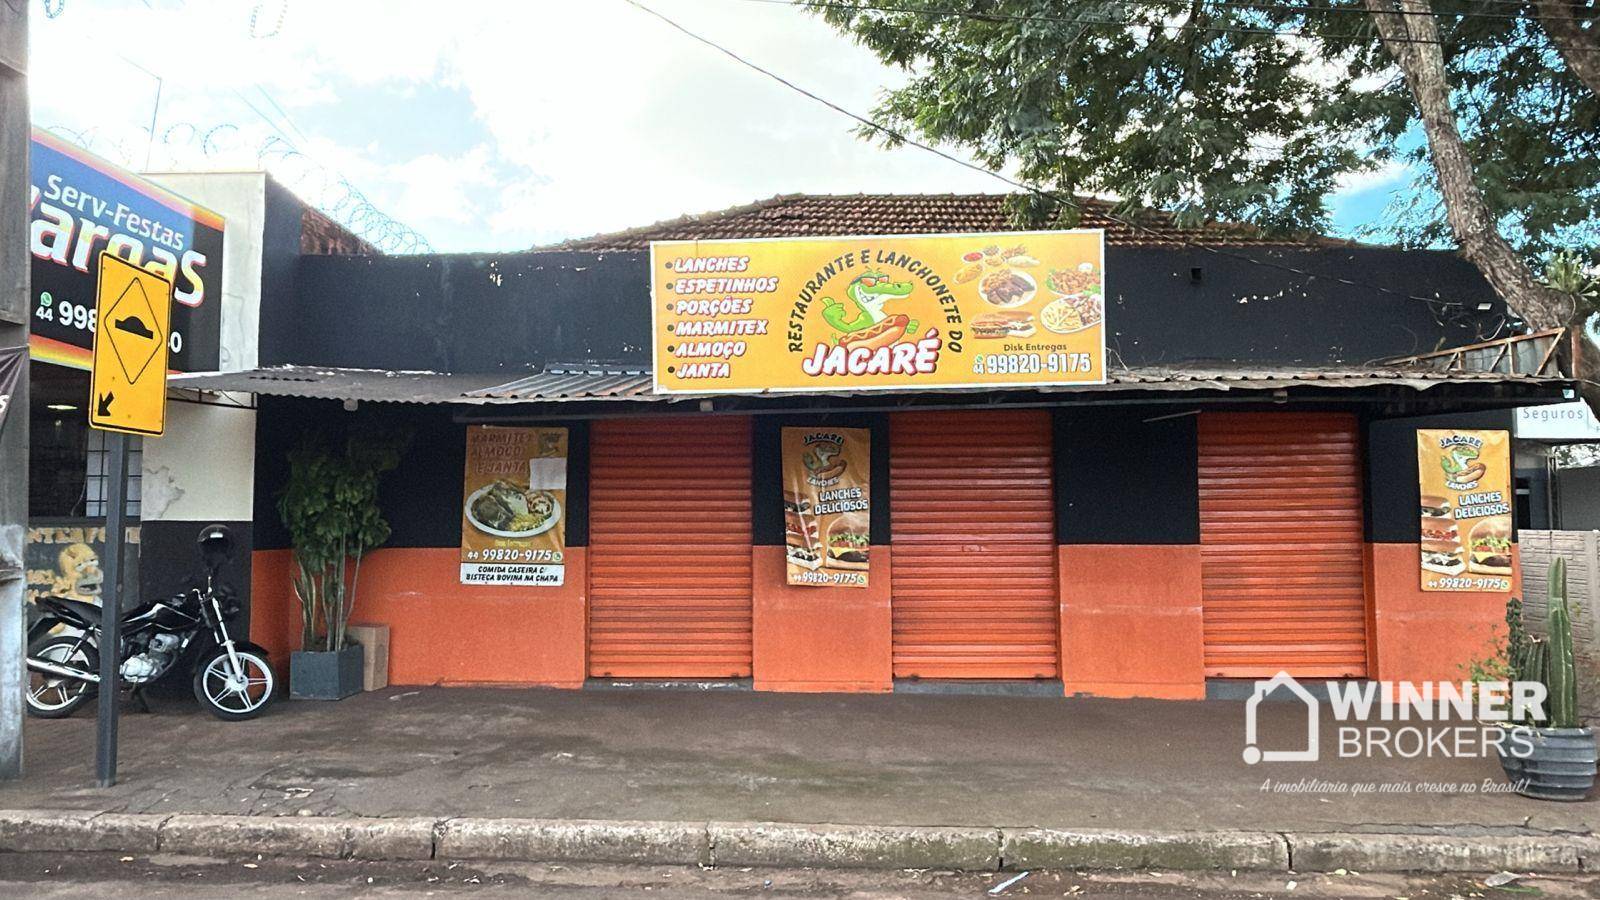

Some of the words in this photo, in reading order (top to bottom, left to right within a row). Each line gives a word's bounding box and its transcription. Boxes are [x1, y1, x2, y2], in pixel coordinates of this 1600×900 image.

[44, 174, 184, 251] Serv-Festas
[674, 255, 750, 273] LANCHES
[675, 276, 780, 294] ESPETINHOS
[675, 297, 754, 318] PORÇÕES
[788, 252, 854, 353] RESTAURANTE
[860, 249, 871, 264] E
[876, 250, 962, 324] LANCHONETE
[947, 330, 963, 353] DO
[36, 305, 54, 322] 44
[675, 319, 769, 337] MARMITEX
[675, 341, 747, 359] ALMOÇO
[802, 327, 943, 376] JACARÉ
[1003, 343, 1023, 352] Disk
[1026, 343, 1067, 353] Entregas
[676, 362, 731, 379] JANTA
[986, 352, 1092, 374] 99820-9175
[1523, 407, 1584, 422] Seguros
[819, 487, 862, 502] LANCHES
[1458, 491, 1502, 506] LANCHES
[814, 499, 868, 517] DELICIOSOS
[1454, 503, 1510, 520] DELICIOSOS
[482, 548, 552, 560] 99820-9175
[466, 573, 495, 581] BISTECA
[524, 574, 534, 582] NA
[508, 566, 538, 574] CASEIRA
[802, 571, 857, 583] 99820-9175
[1439, 577, 1501, 589] 99820-9175
